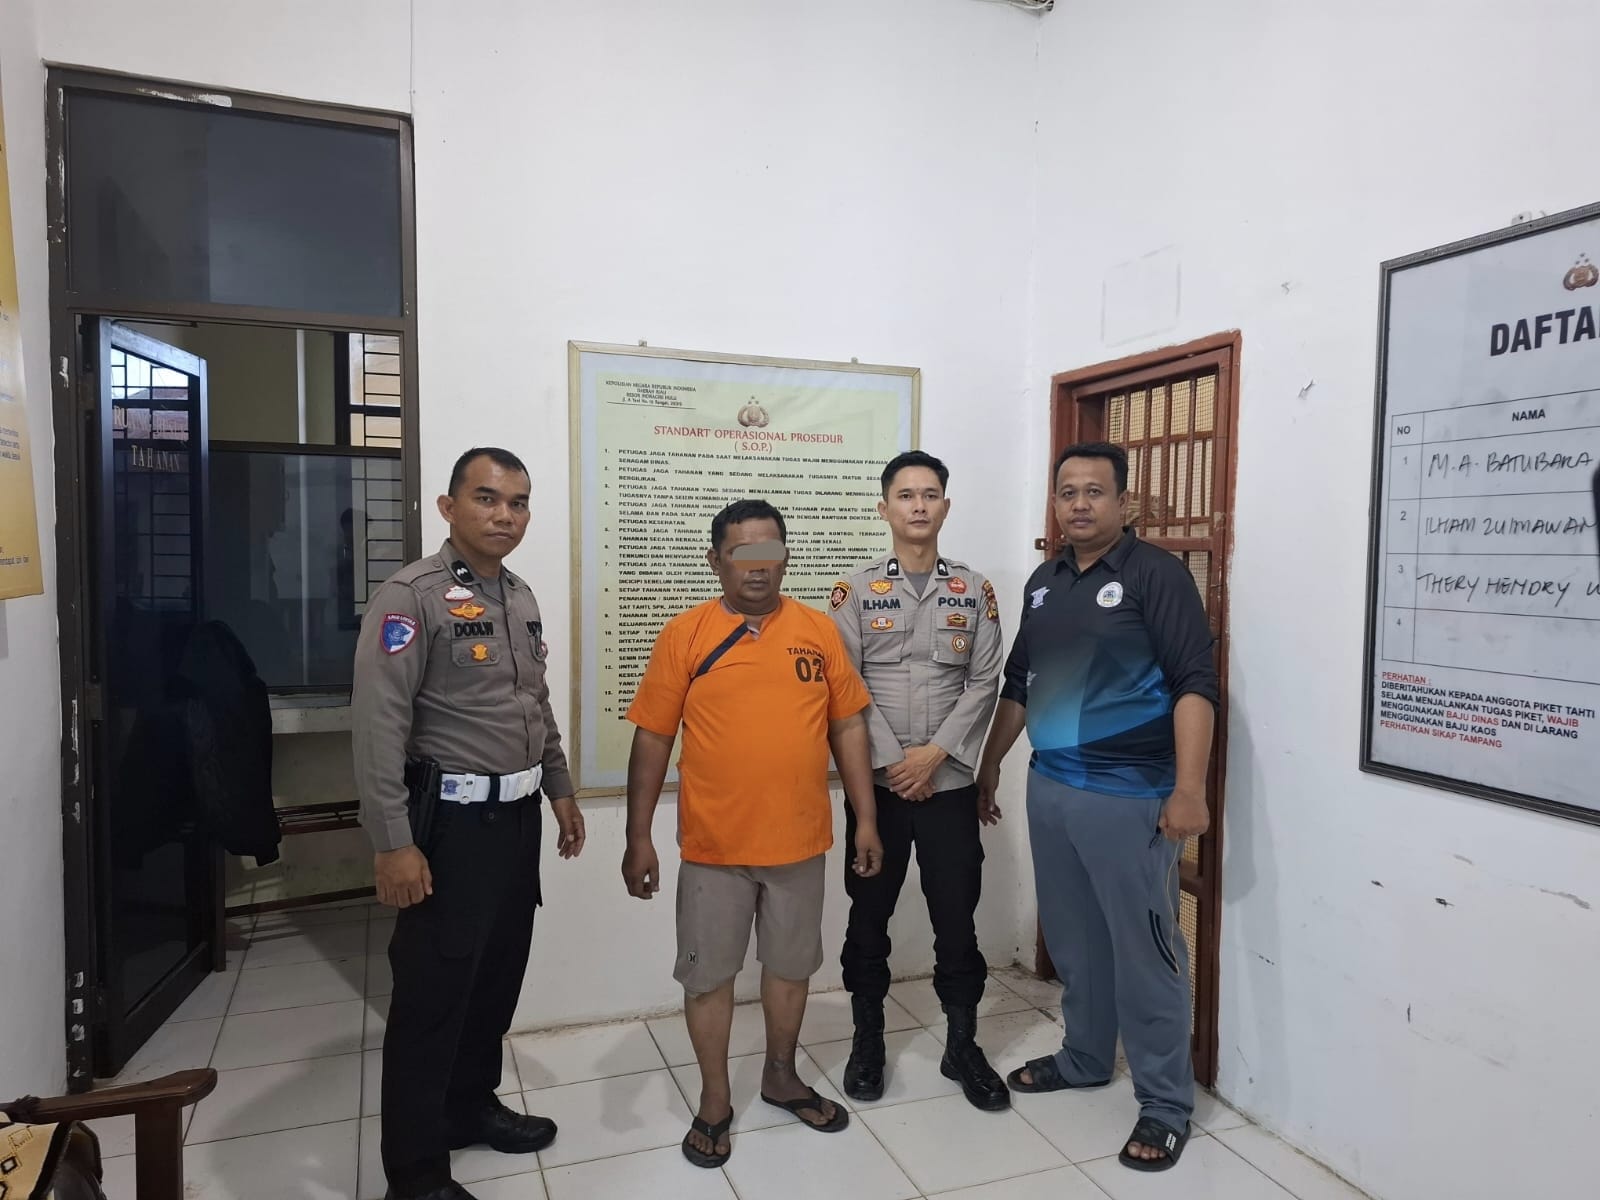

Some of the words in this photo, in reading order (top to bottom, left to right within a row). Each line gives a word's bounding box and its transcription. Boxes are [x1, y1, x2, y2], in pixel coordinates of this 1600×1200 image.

[1490, 305, 1600, 356] DAFTA
[1511, 408, 1546, 422] NAMA
[654, 425, 710, 438] STANDART
[714, 428, 787, 442] OPERASIONAL
[790, 432, 844, 444] PROSEDUR
[1396, 425, 1411, 436] NO
[1400, 511, 1407, 521] 2
[1398, 564, 1404, 574] 3
[862, 598, 901, 610] ILHAM
[938, 596, 976, 609] POLRI
[795, 656, 824, 682] 02
[1382, 671, 1426, 684] PERHATIAN
[1381, 690, 1414, 702] SELAMA
[1415, 696, 1479, 712] MENJALANKAN
[1482, 705, 1512, 718] TUGAS
[1514, 710, 1544, 724] PIKET,
[1546, 714, 1579, 728] WAJIB
[1382, 681, 1446, 697] DIBERITAHUKAN
[1448, 690, 1484, 702] KEPADA
[1485, 696, 1532, 710] ANGGOTA
[1533, 702, 1562, 714] PIKET
[1566, 706, 1596, 718] TAHTI
[1380, 700, 1444, 718] MENGGUNAKAN
[1446, 710, 1470, 722] BAJU
[1472, 714, 1499, 726] DINAS
[1502, 719, 1520, 730] DAN
[1524, 722, 1533, 732] DI
[1536, 726, 1578, 739] LARANG
[1380, 710, 1444, 728] MENGGUNAKAN
[1446, 720, 1469, 732] BAJU
[1471, 725, 1497, 736] KAOS
[1380, 720, 1430, 735] PERHATIKAN
[1432, 728, 1457, 740] SIKAP
[1459, 733, 1502, 748] TAMPANG
